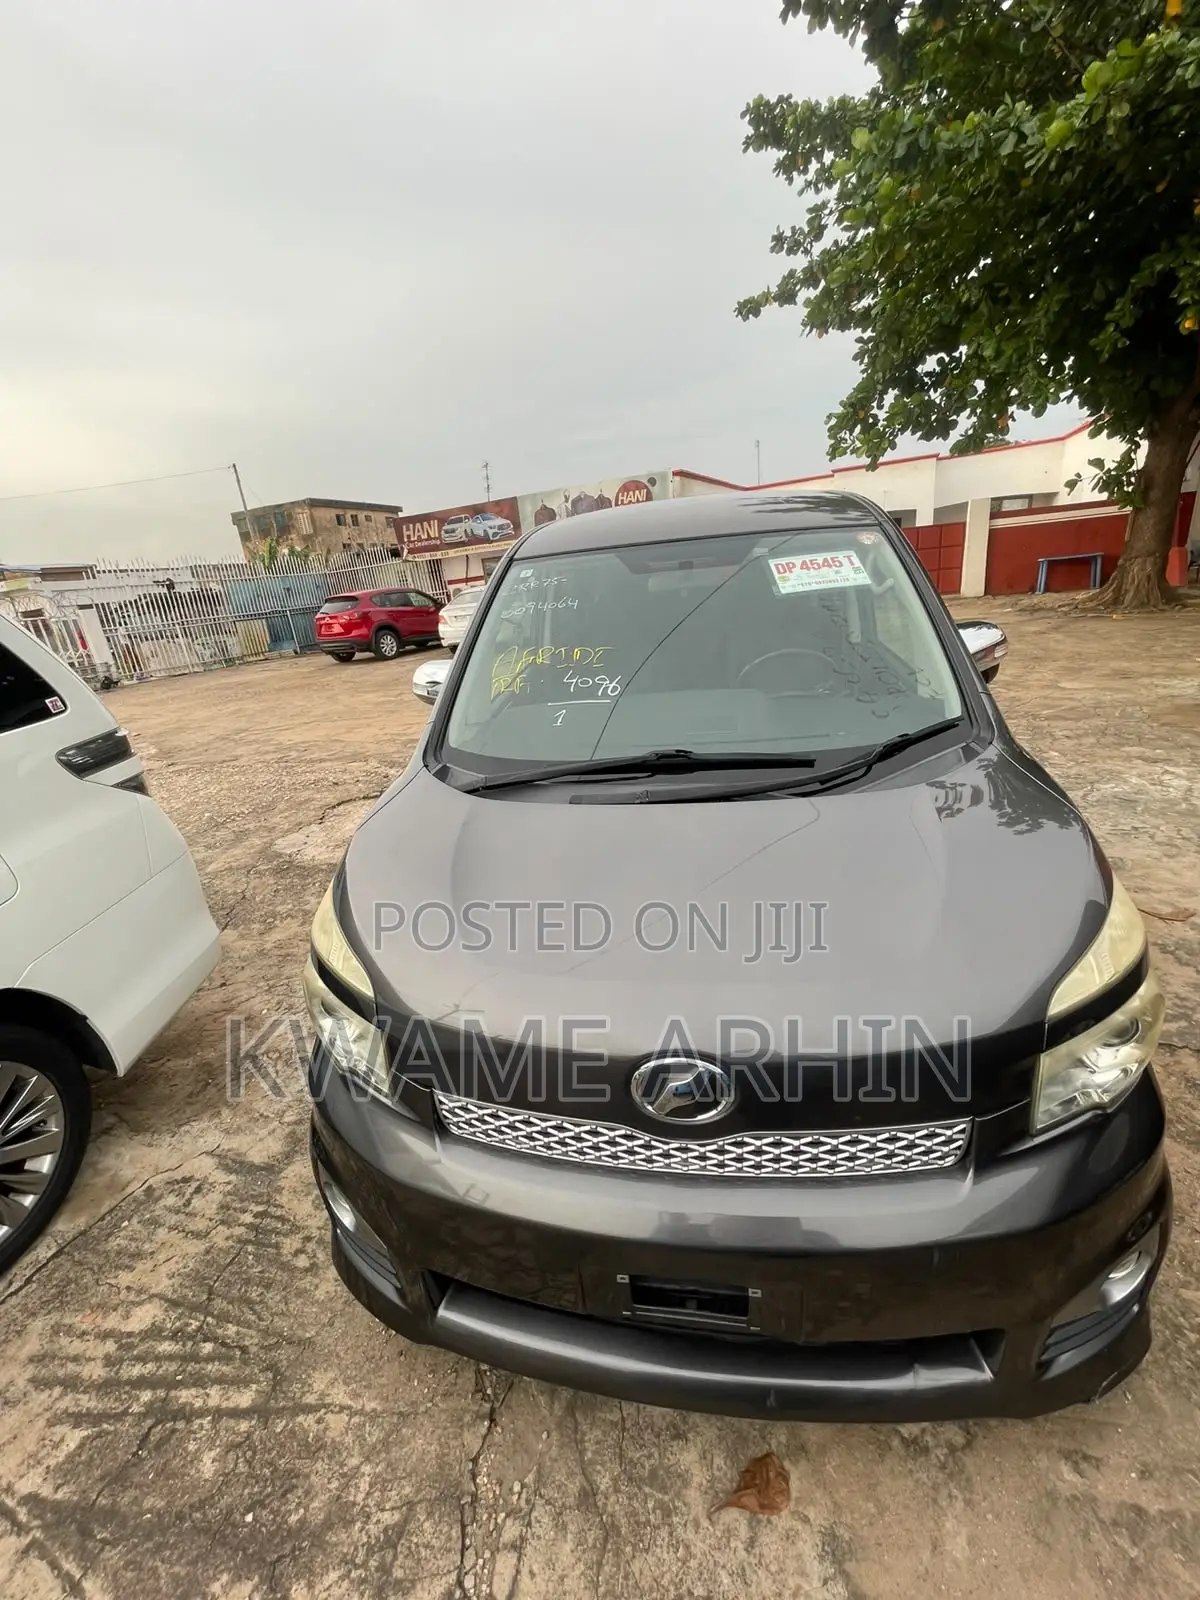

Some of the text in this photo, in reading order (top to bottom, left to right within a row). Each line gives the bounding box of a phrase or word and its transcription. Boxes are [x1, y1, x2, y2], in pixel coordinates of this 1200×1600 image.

[618, 488, 647, 505] HANI
[402, 520, 439, 542] HANI
[415, 539, 440, 547] Dealership
[773, 562, 797, 576] DP
[799, 556, 844, 572] 4545
[843, 554, 857, 567] T
[563, 669, 622, 697] 4096
